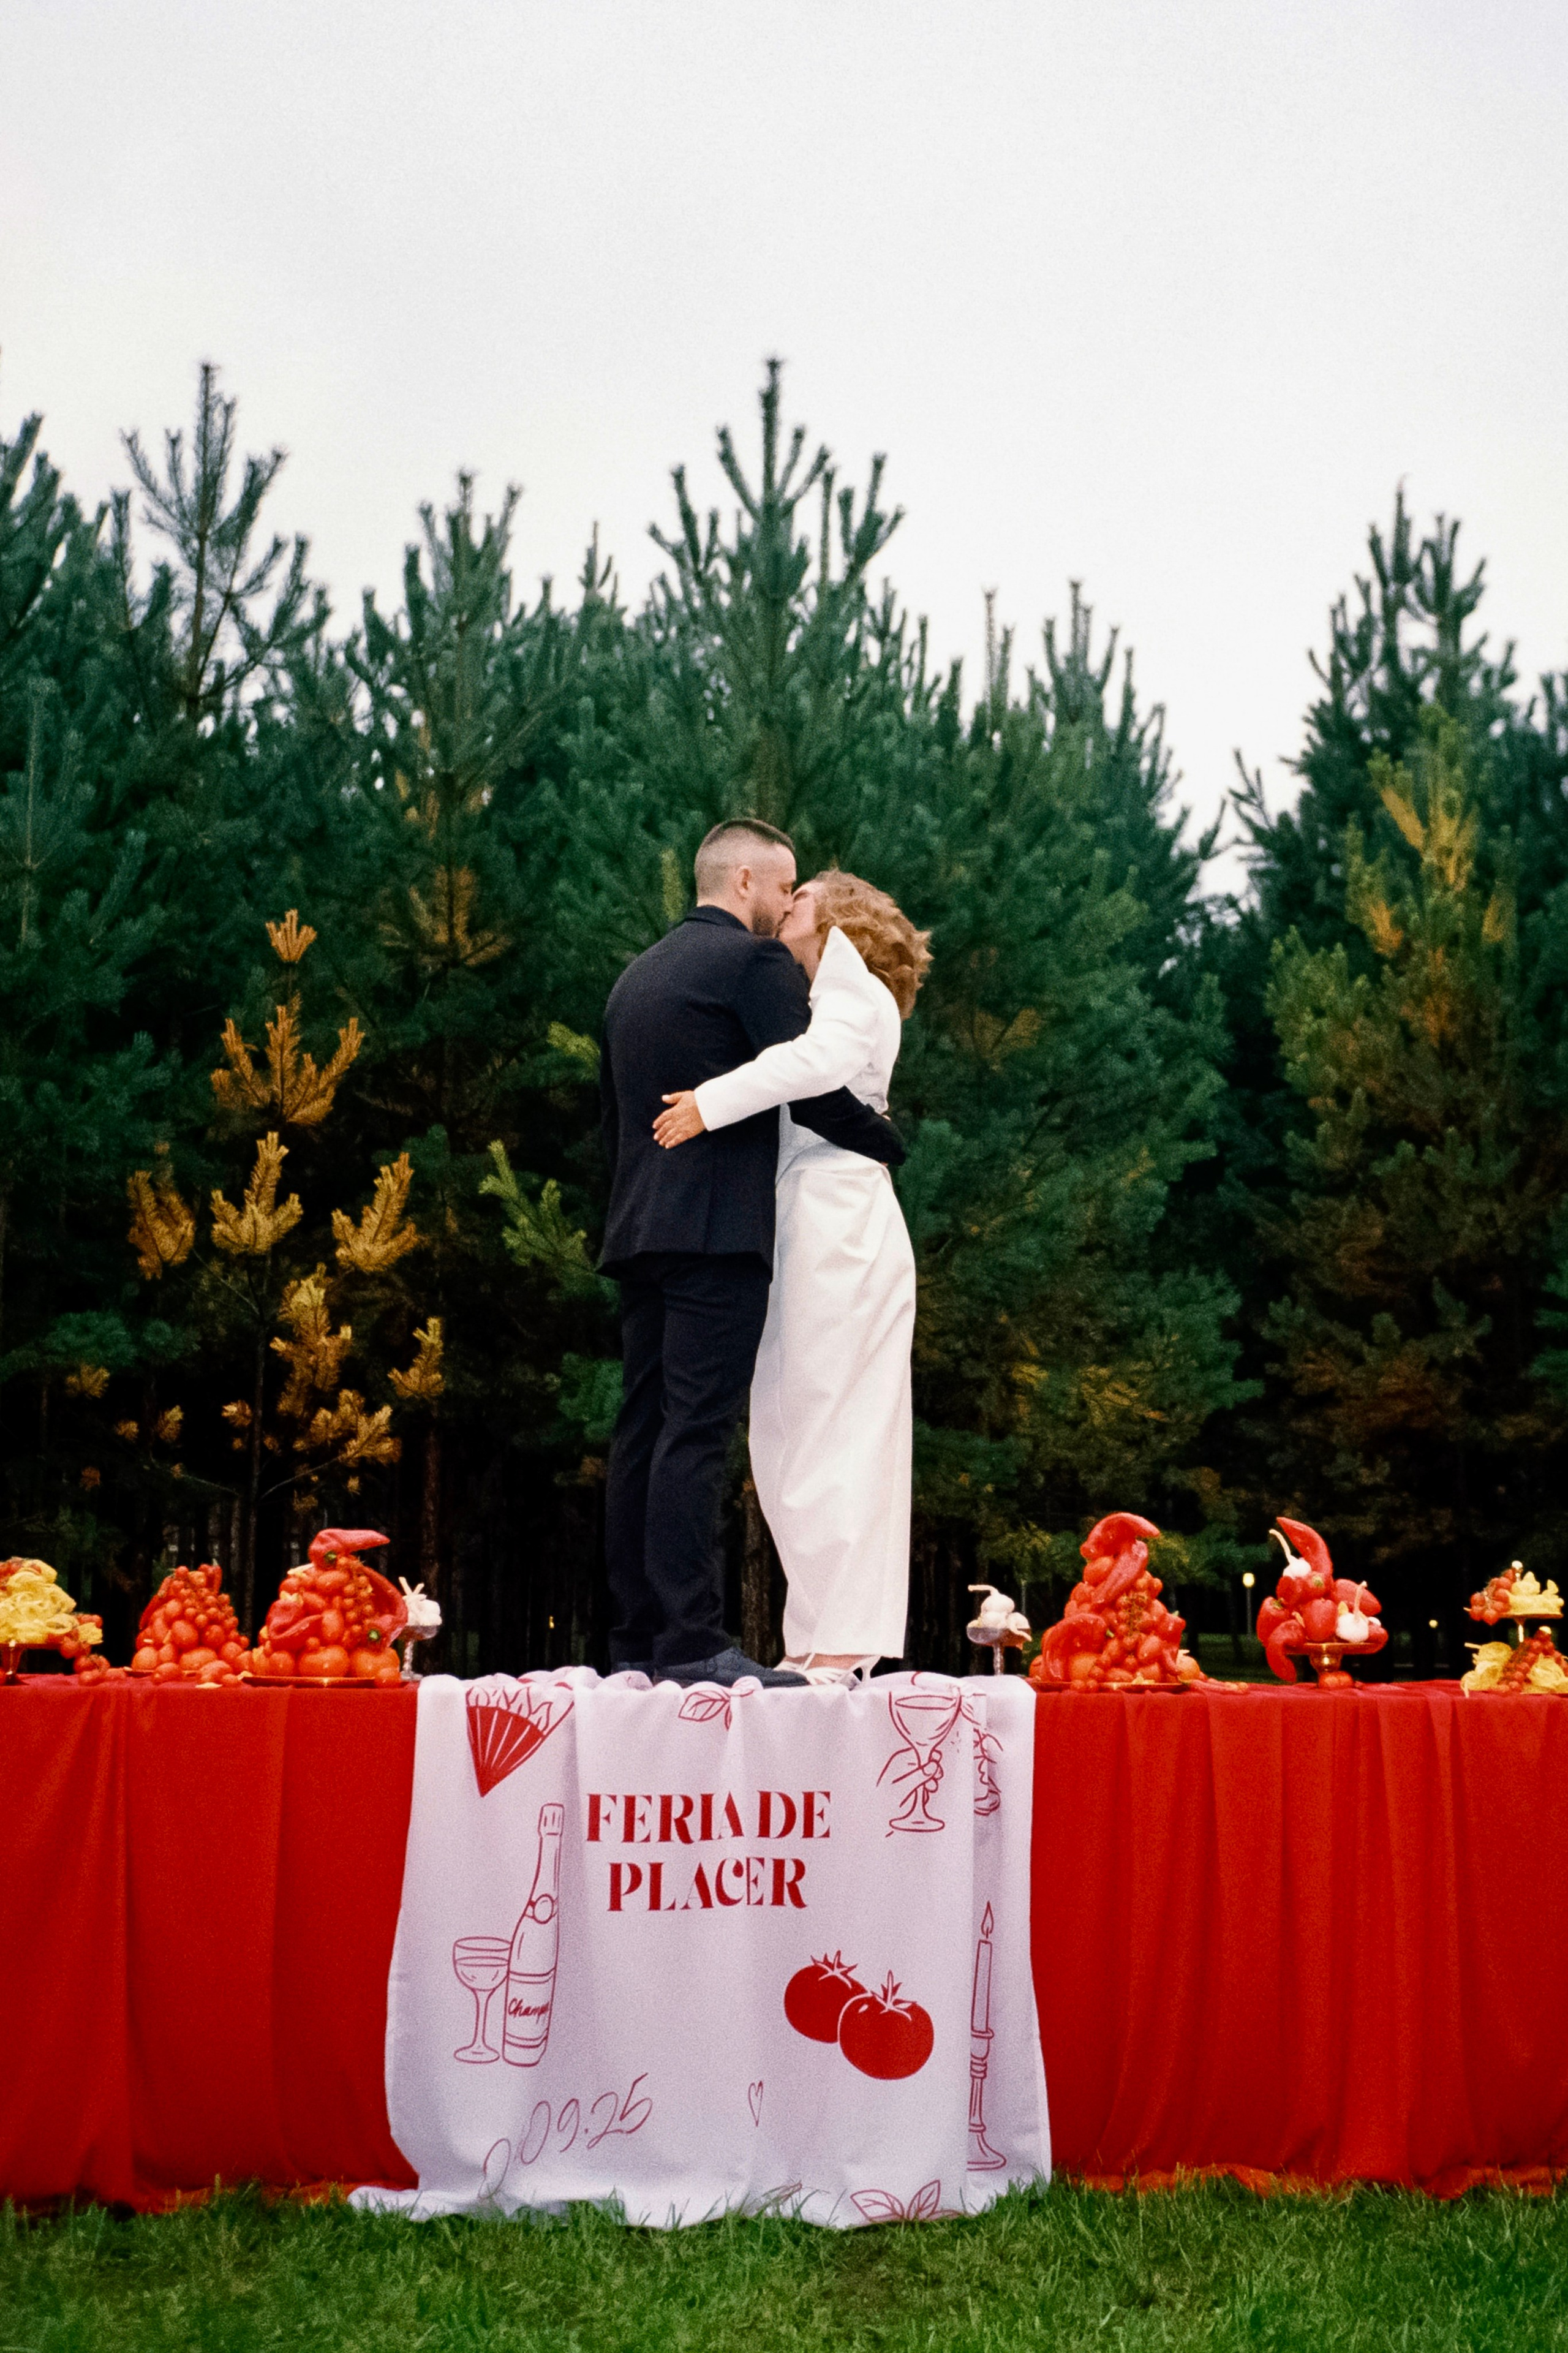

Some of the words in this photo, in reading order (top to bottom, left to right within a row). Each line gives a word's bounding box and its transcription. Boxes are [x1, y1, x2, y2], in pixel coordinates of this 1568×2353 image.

[587, 1791, 745, 1845] FERIA
[757, 1790, 831, 1839] DE
[607, 1856, 808, 1911] PLACER
